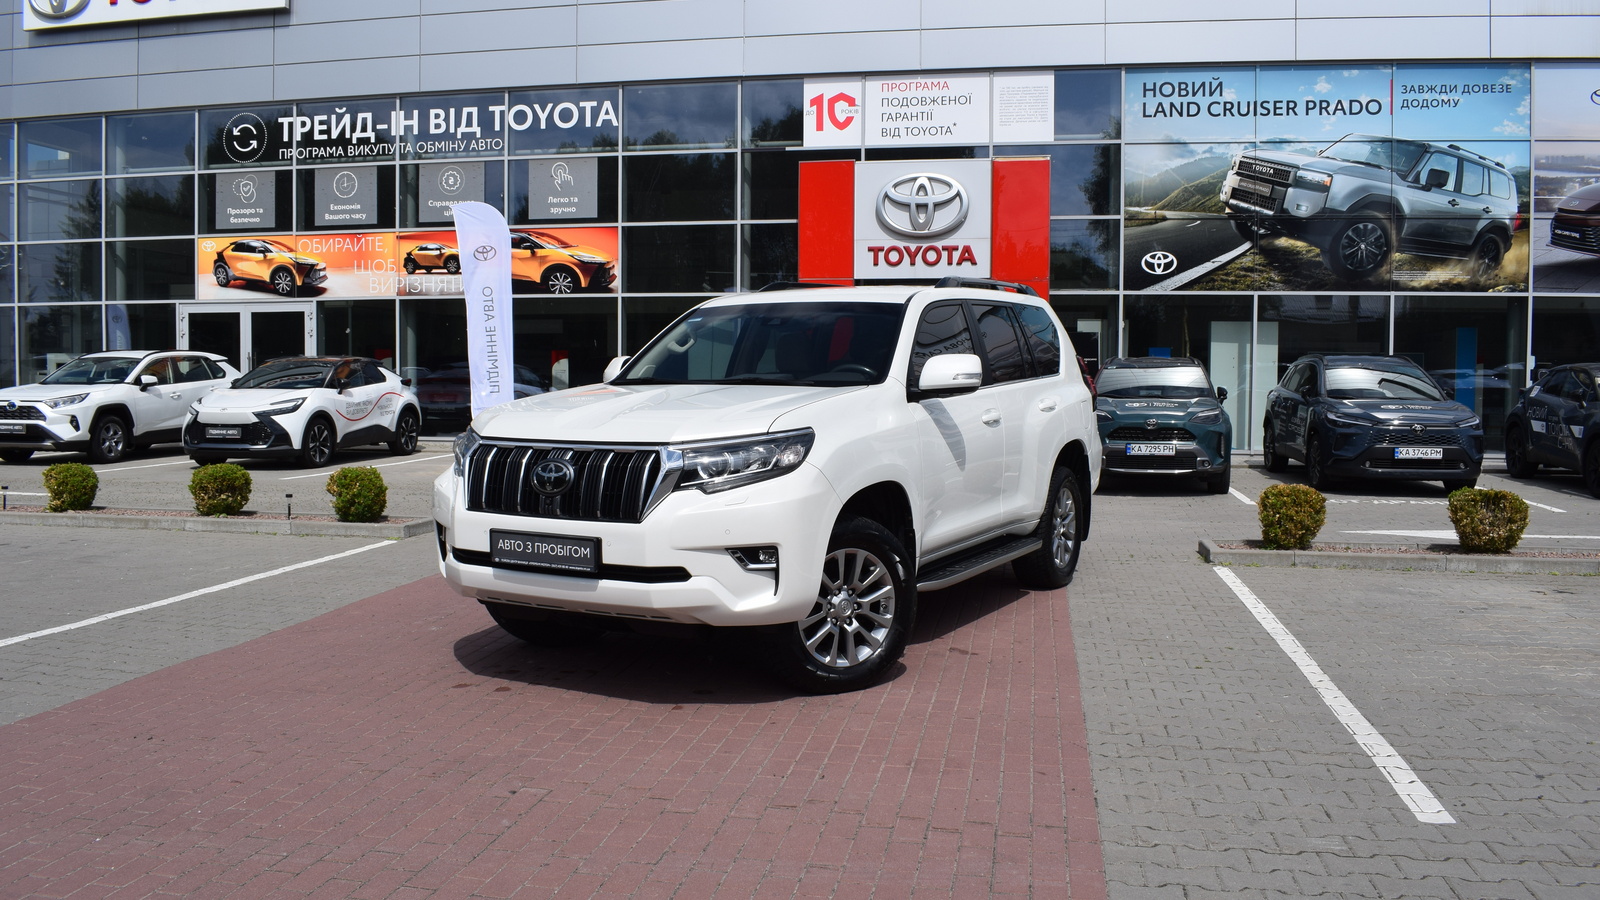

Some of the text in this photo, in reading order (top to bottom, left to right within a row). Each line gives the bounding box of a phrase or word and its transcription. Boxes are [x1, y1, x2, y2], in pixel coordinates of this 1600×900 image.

[881, 81, 950, 92] ПРОГРАМА
[1142, 77, 1223, 98] НОВИЙ
[1401, 83, 1512, 95] ЗАВЖДИ ДОВЕЗЕ
[881, 92, 973, 108] ПОДОВЖЕНОЇ
[1400, 98, 1461, 110] ДОДОМУ
[1142, 99, 1383, 118] LAND CRUISER PRADO
[278, 100, 619, 144] ТРЕЙД-ІН ВІД TOYOTA
[881, 109, 934, 123] ГАРАНТІЇ
[881, 126, 901, 139] ВІД
[279, 138, 503, 160] ПРОГРАМА ВИКУПУ ТА ОБМІНУ АВТО
[1252, 164, 1274, 174] TOYOTA
[548, 196, 569, 204] Легко
[227, 207, 256, 215] Прозоро
[330, 203, 361, 211] Економія
[550, 206, 576, 214] зручно
[230, 216, 261, 224] безпечно
[350, 212, 367, 220] часу
[867, 245, 978, 267] TOYOTA
[353, 259, 397, 276] ЩОБ
[1548, 422, 1571, 436] TOYOTA
[1131, 445, 1174, 453] KA 7295 PH
[1399, 448, 1442, 457] KA 3746 PM
[497, 539, 590, 558] АВТО З ПРОБІГОМ
